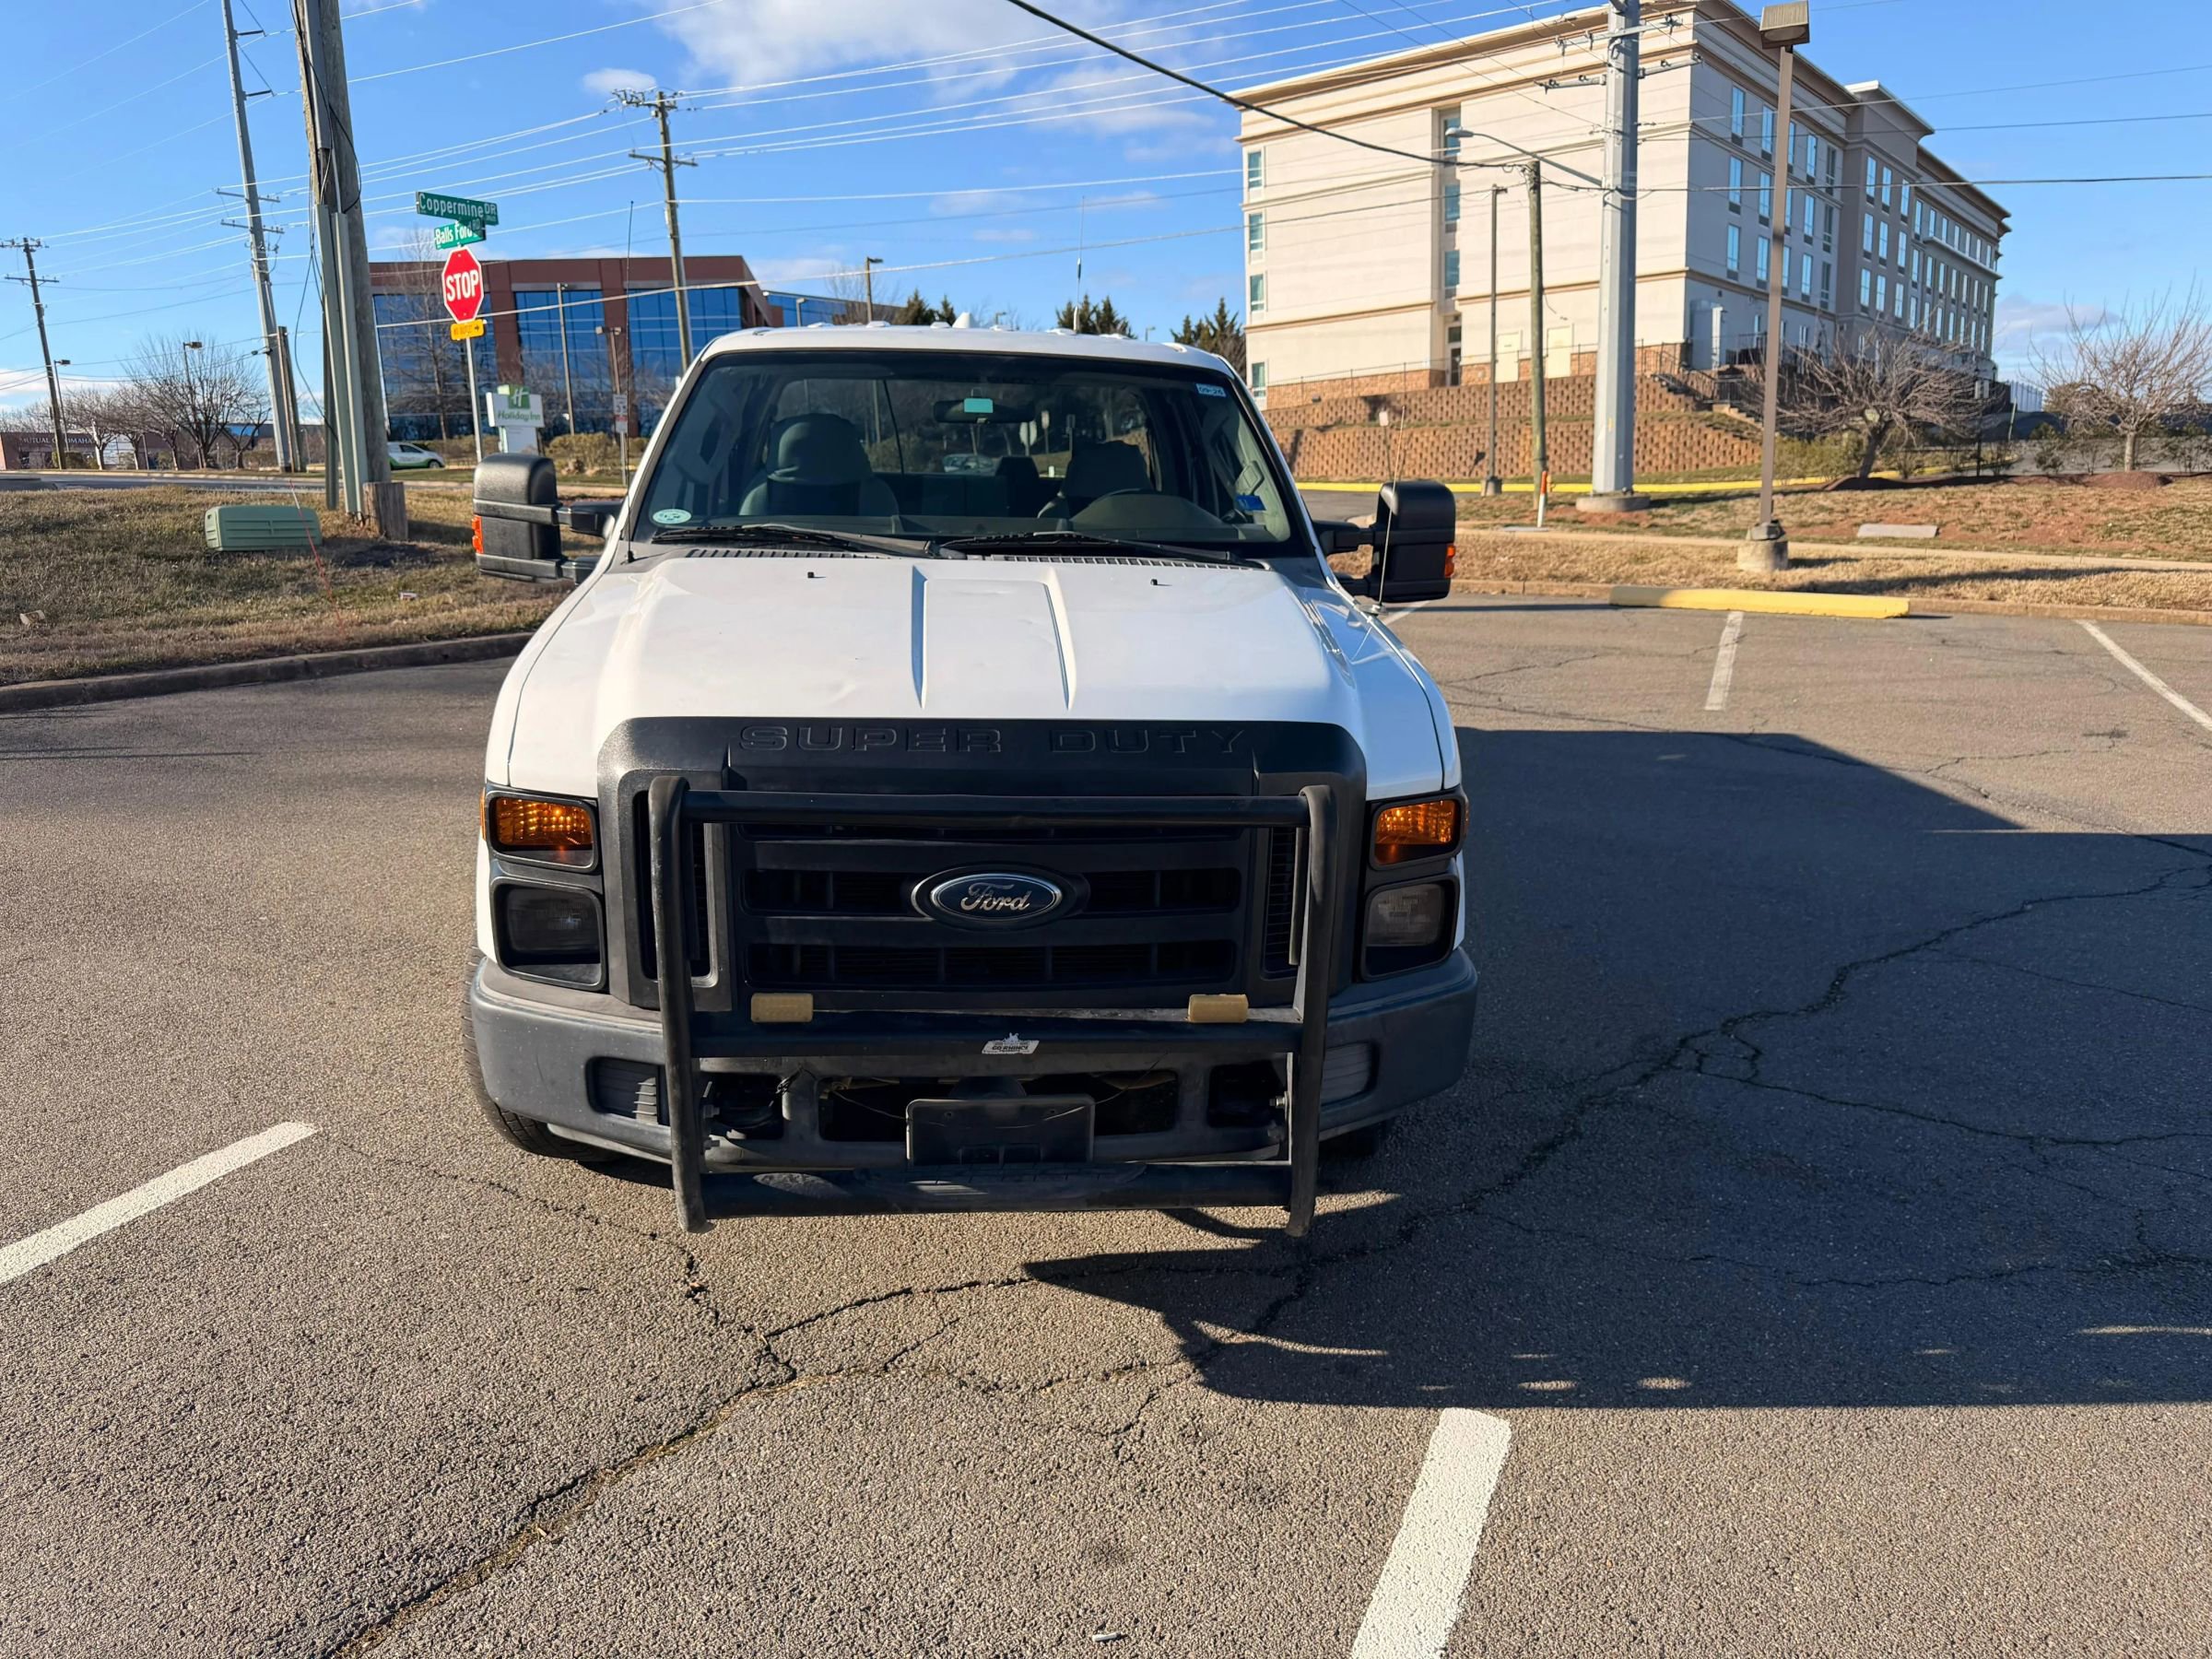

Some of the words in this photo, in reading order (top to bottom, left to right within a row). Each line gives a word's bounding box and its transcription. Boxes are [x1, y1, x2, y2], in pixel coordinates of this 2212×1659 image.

[418, 194, 484, 218] Coppermine
[484, 203, 497, 215] DR
[435, 226, 453, 245] Balls
[454, 222, 473, 241] Ford
[446, 269, 479, 301] STOP
[498, 410, 529, 422] Holiday
[739, 725, 1001, 752] SUPER
[1049, 729, 1244, 754] DUTY
[960, 882, 1030, 911] Ford
